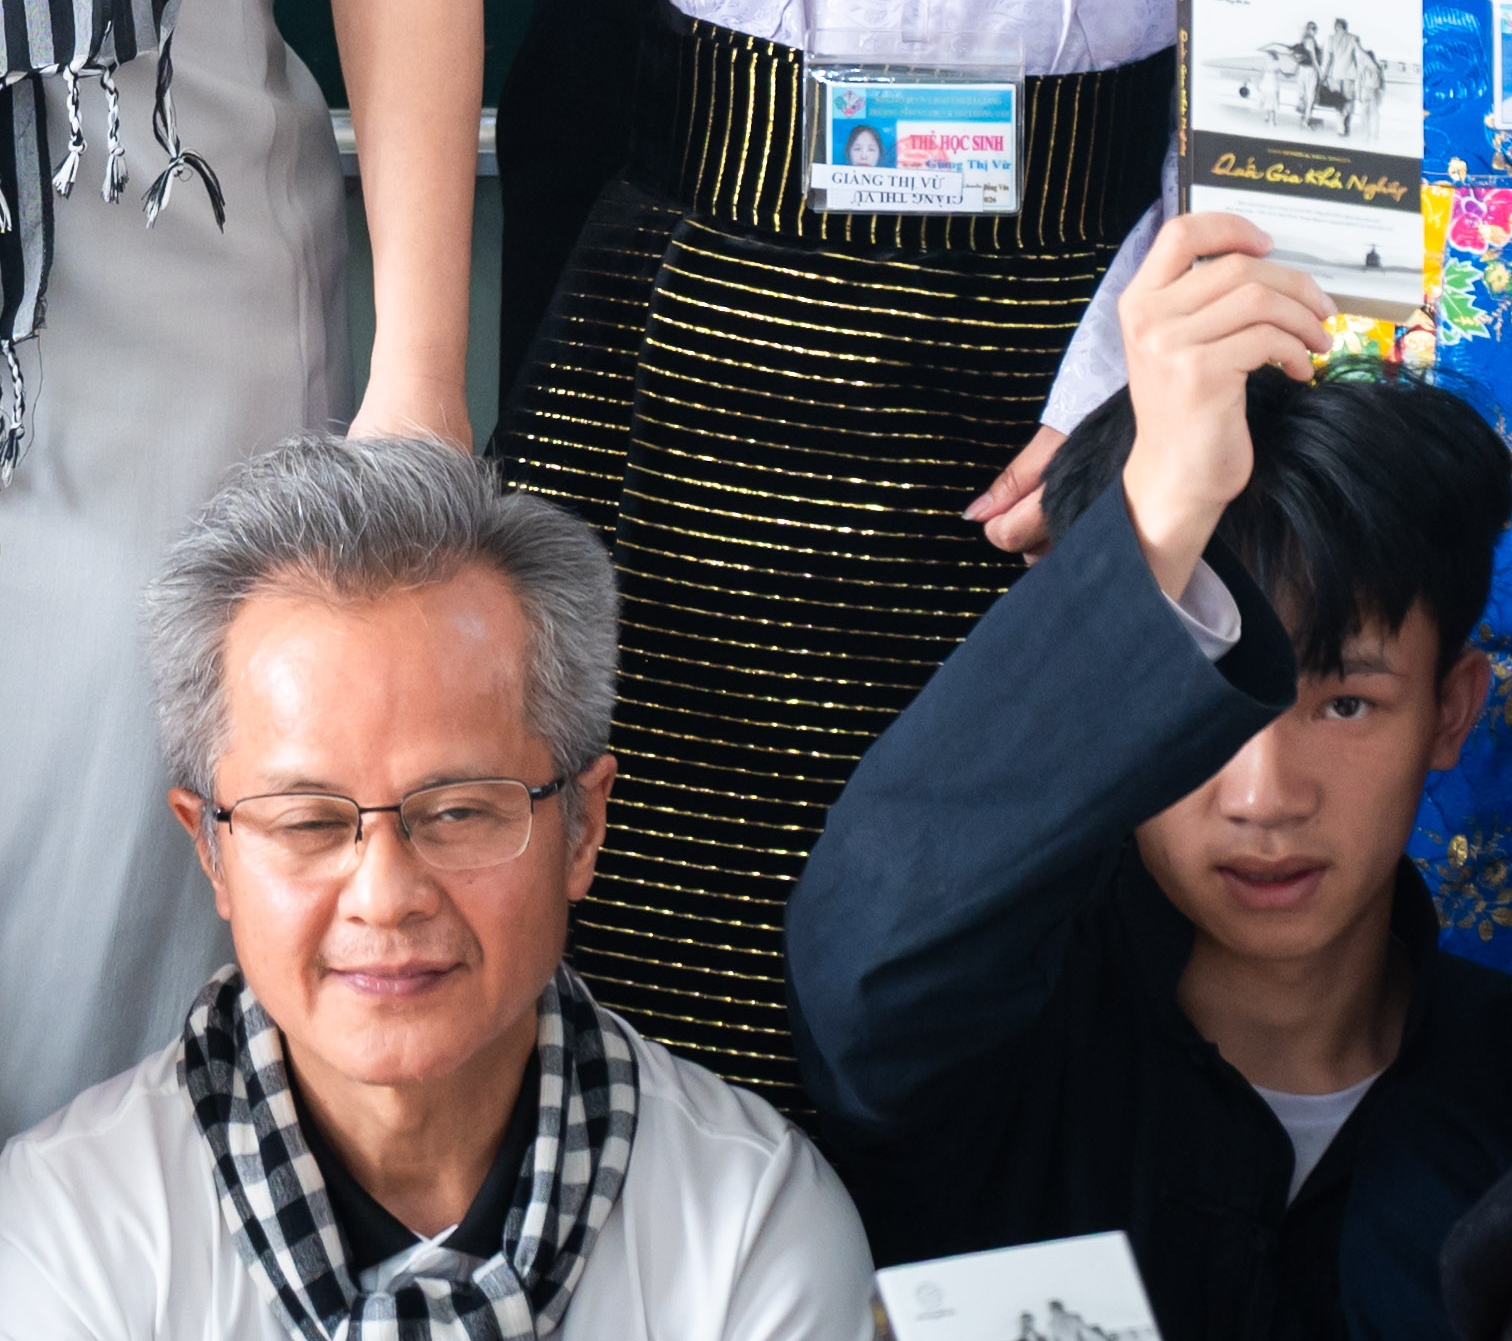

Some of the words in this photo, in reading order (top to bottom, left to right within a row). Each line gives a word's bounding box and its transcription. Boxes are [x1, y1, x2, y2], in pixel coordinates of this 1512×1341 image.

[910, 131, 936, 151] THẺ
[940, 134, 969, 154] HỌC
[972, 135, 1004, 151] SINH
[968, 159, 988, 172] Thị
[1266, 165, 1304, 185] Gia
[832, 171, 883, 187] GIÀNG
[888, 175, 916, 190] THỊ
[921, 176, 945, 190] VỪ
